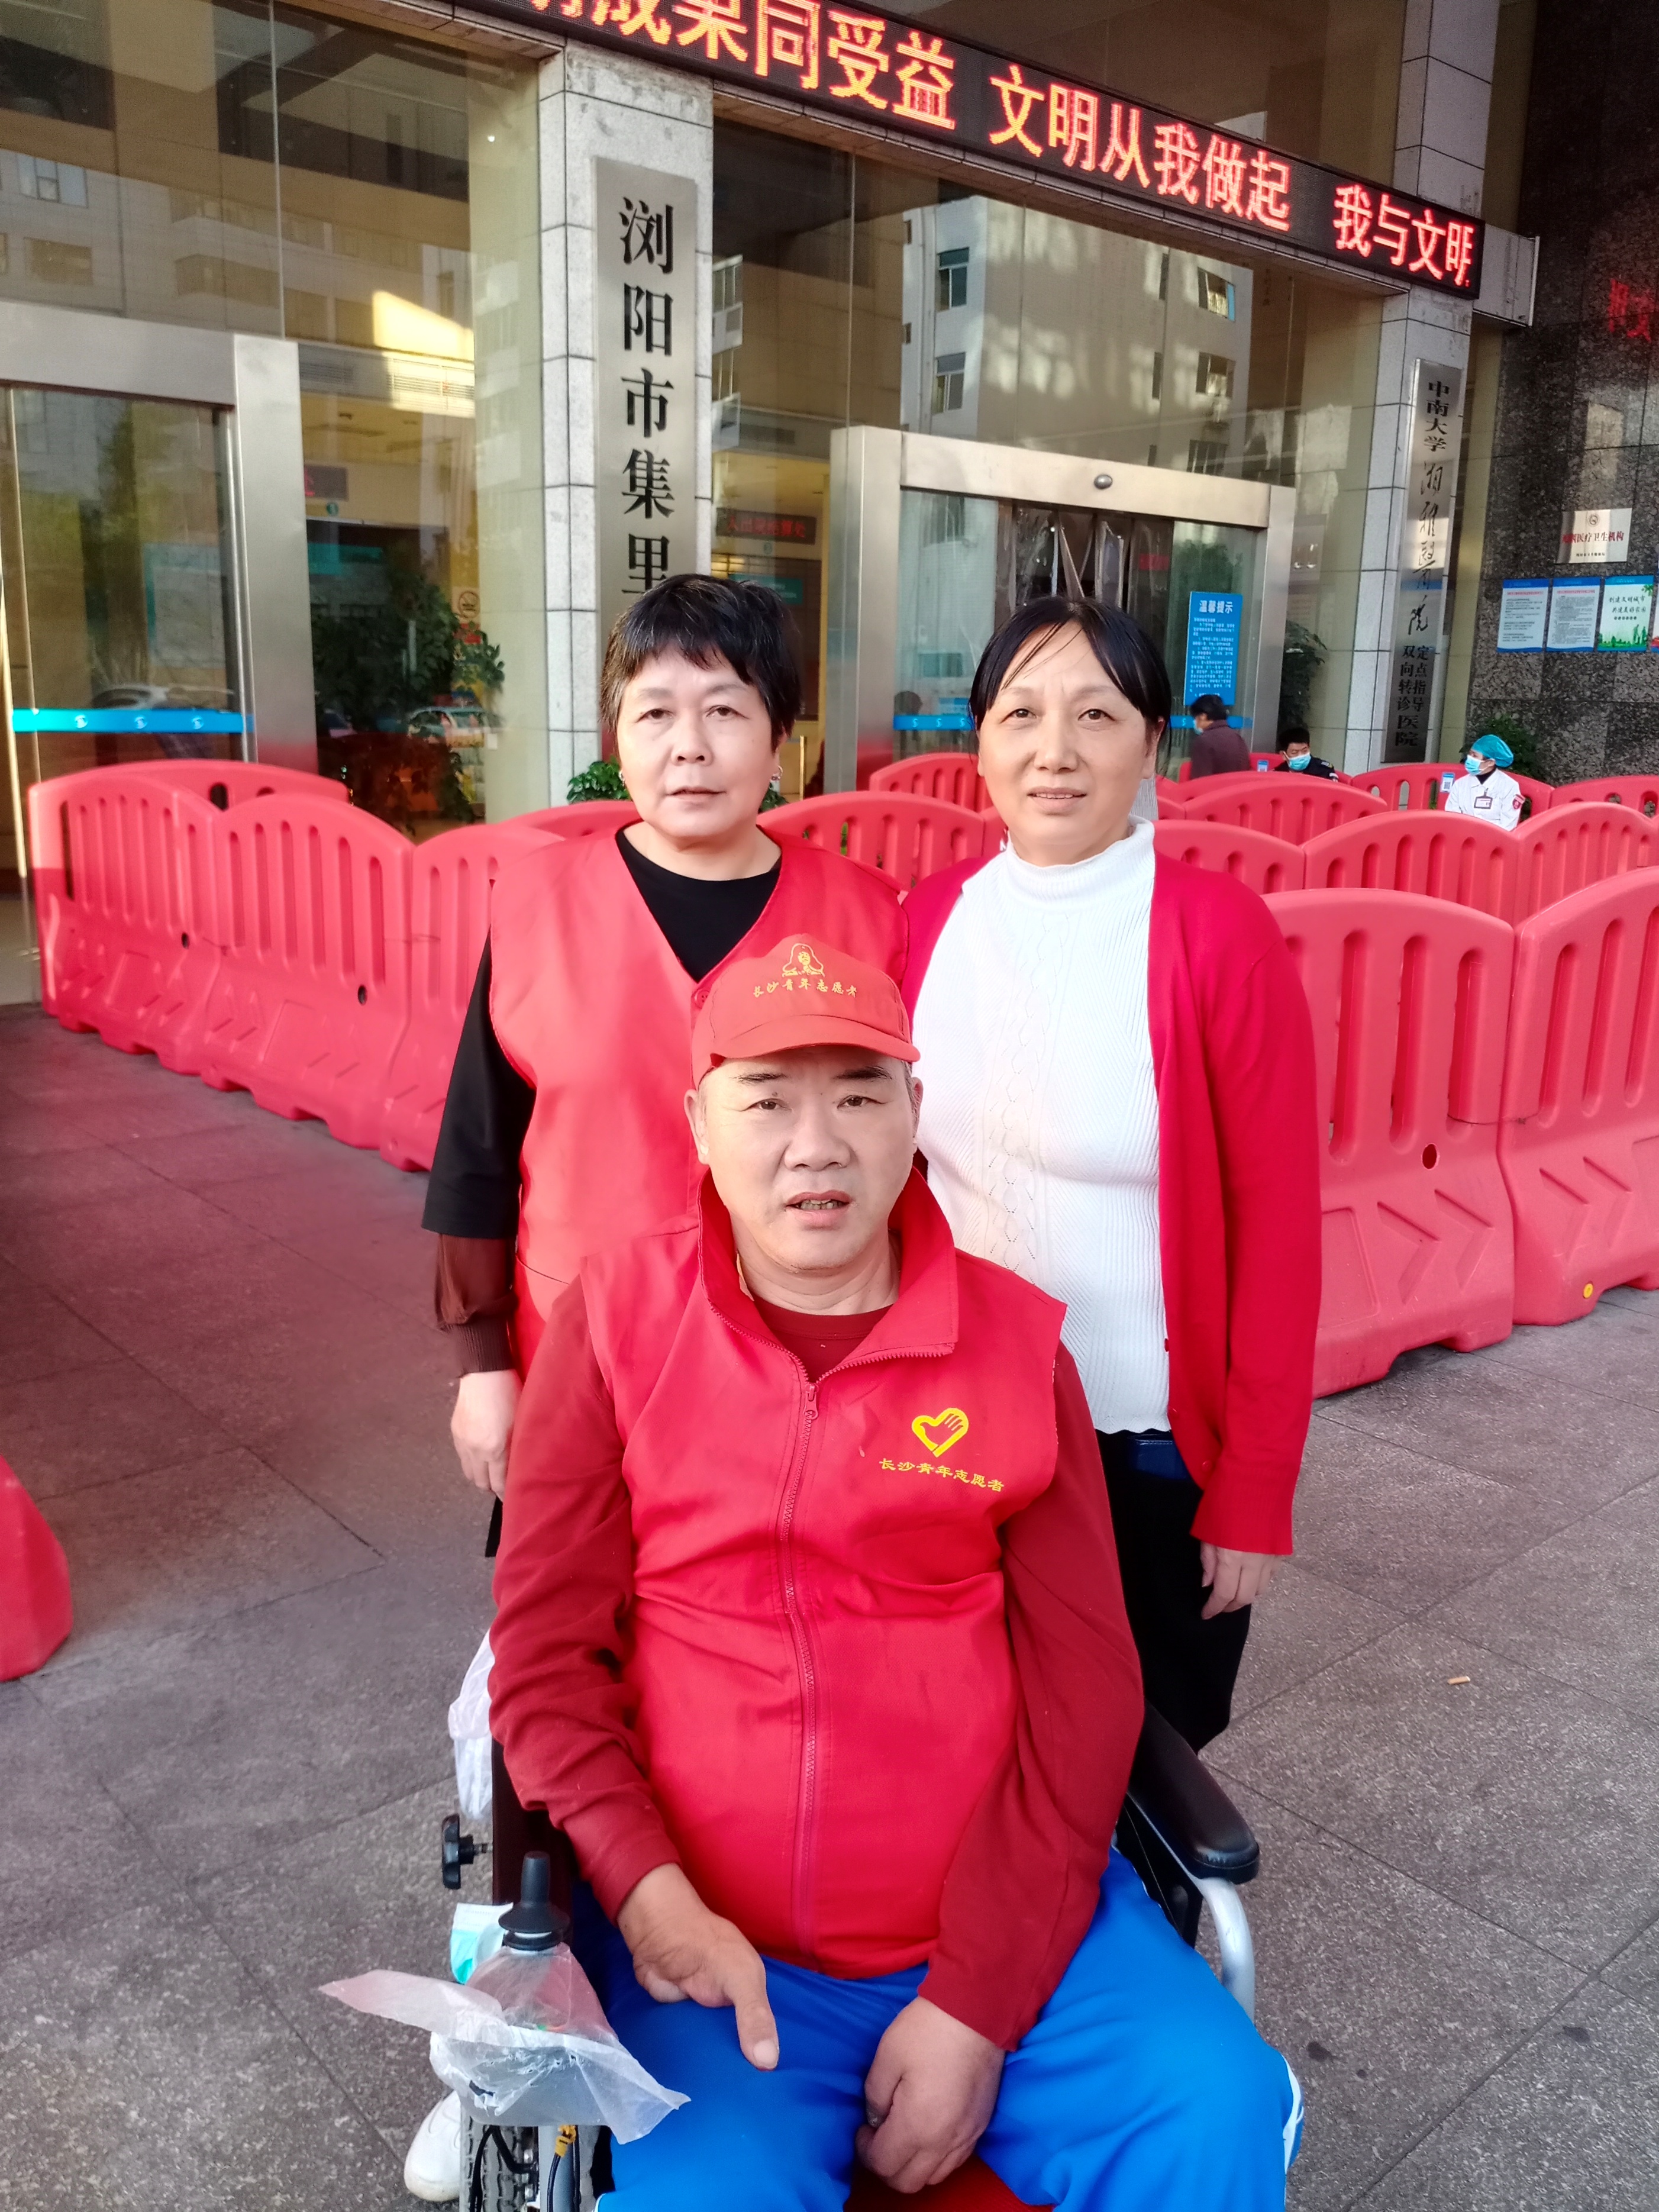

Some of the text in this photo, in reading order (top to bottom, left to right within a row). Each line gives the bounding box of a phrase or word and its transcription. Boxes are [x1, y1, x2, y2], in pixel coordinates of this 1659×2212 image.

[530, 0, 1476, 288] 果同受益 文明从我做起 我与文明
[619, 196, 675, 594] 浏阳市集里
[1199, 599, 1233, 614] 温馨提示
[1397, 645, 1415, 711] 双向转诊
[1413, 645, 1429, 712] 定点指导
[1395, 714, 1419, 747] 医院
[753, 978, 858, 998] 长沙青年志愿者
[879, 1458, 1005, 1492] 长沙青年志愿者
